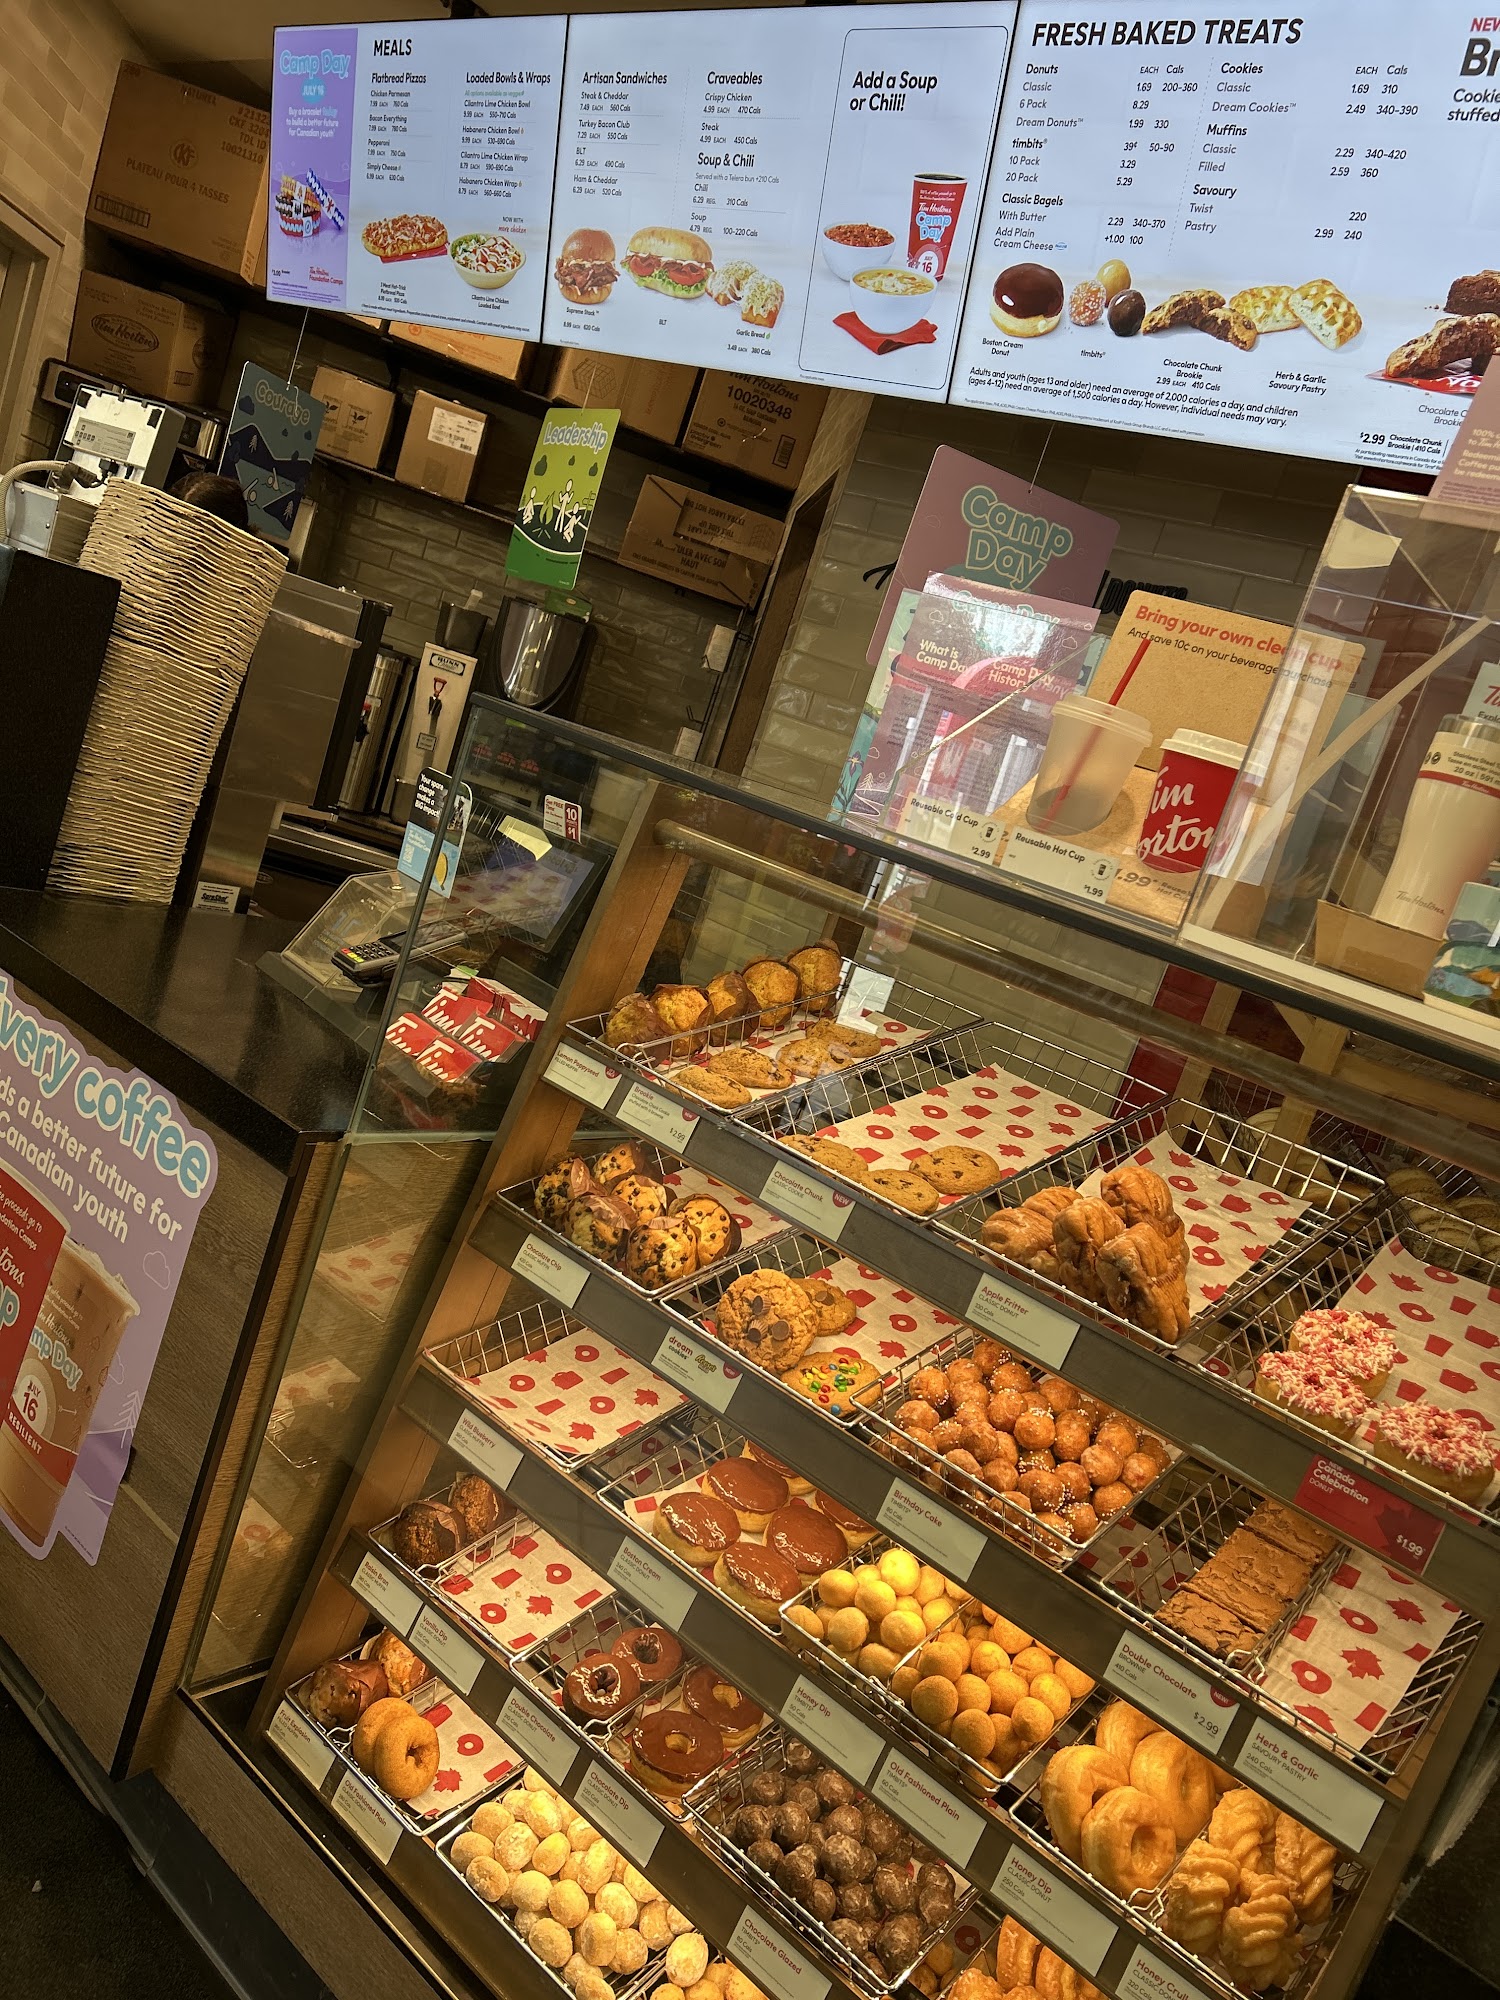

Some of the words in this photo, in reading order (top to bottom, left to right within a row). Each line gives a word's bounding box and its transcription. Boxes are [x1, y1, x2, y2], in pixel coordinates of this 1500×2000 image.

[1032, 22, 1107, 46] FRESH
[1111, 20, 1196, 45] BAKED
[1204, 18, 1304, 45] TREATS
[373, 39, 412, 56] MEALS
[280, 50, 319, 79] Camp
[320, 49, 349, 79] Day
[1026, 64, 1058, 74] Donuts
[1140, 66, 1159, 74] EACH
[1167, 64, 1184, 74] Cals
[1221, 63, 1263, 74] Cookies
[1356, 67, 1378, 75] EACH
[1387, 65, 1408, 75] Cals
[371, 73, 404, 83] Flatbread
[405, 73, 426, 83] Pizzas
[466, 72, 494, 83] Loaded
[496, 73, 516, 83] Bowls
[518, 73, 523, 83] &
[526, 72, 550, 85] Wraps
[583, 72, 614, 84] Artisan
[616, 72, 667, 85] Sandwiches
[707, 71, 762, 85] Craveables
[853, 71, 884, 89] Add
[886, 75, 895, 89] a
[899, 71, 937, 93] Soup
[1023, 82, 1052, 91] Classic
[1137, 83, 1151, 92] 1.69
[1162, 83, 1198, 92] 200-360
[1217, 82, 1251, 92] Classic
[1351, 84, 1369, 94] 1.69
[1382, 85, 1398, 94] 310
[705, 93, 725, 102] Crispy
[726, 93, 752, 101] Chicken
[850, 97, 866, 111] or
[869, 94, 905, 111] Chili!
[1019, 100, 1025, 109] 6
[1027, 99, 1047, 109] Pack
[1133, 100, 1149, 110] 8.29
[579, 120, 596, 129] Turkey
[598, 120, 615, 128] Bacon
[616, 120, 630, 129] Club
[702, 123, 719, 131] Steak
[1207, 124, 1247, 136] Muffins
[698, 153, 722, 168] Soup
[724, 154, 730, 166] &
[733, 154, 754, 167] Chili
[125, 157, 163, 180] PLATEAU
[164, 173, 188, 188] POUR
[199, 184, 230, 204] TASSES
[1193, 184, 1237, 198] Savoury
[1002, 194, 1032, 205] Classic
[1034, 195, 1063, 207] Bagels
[916, 212, 951, 227] Camp
[1185, 220, 1216, 233] Pastry
[1314, 229, 1333, 238] 2.99
[1344, 230, 1362, 240] 240
[919, 226, 943, 242] Day
[922, 262, 932, 273] 16
[1276, 371, 1294, 381] Herb
[1296, 373, 1301, 382] &
[1304, 373, 1326, 384] Garlic
[255, 379, 310, 425] Courage
[728, 384, 792, 420] 10020348
[543, 421, 608, 454] Leadership
[1360, 432, 1385, 445] $2.99
[961, 485, 1073, 559] Camp
[966, 529, 1046, 590] Day
[920, 639, 949, 656] What
[951, 646, 958, 659] is
[1128, 627, 1149, 640] And
[1150, 635, 1172, 646] save
[1174, 640, 1190, 651] 10¢
[1191, 646, 1204, 654] on
[1205, 648, 1230, 661] your
[1231, 653, 1278, 675] beverage
[1135, 605, 1179, 631] Bring
[1181, 619, 1218, 637] your
[1219, 627, 1254, 647] own
[1308, 651, 1342, 671] cup
[419, 783, 435, 799] change
[421, 773, 433, 785] Your
[431, 778, 444, 790] spare
[566, 807, 576, 821] 10
[910, 797, 944, 816] Reusable
[944, 808, 961, 821] Cold
[962, 815, 979, 828] Cup
[568, 827, 576, 839] $1
[971, 846, 991, 859] $2.99
[1015, 832, 1051, 852] Reusable
[1052, 844, 1069, 855] Hot
[1070, 850, 1086, 863] Cup
[1084, 884, 1104, 897] $1.99
[75, 1066, 212, 1199] coffee
[0, 1110, 74, 1196] Canadian
[73, 1182, 130, 1243] youth
[17, 1098, 30, 1119] a
[31, 1099, 88, 1163] better
[88, 1147, 148, 1215] future
[150, 1196, 183, 1241] for
[774, 1171, 804, 1190] Chocolate
[804, 1188, 824, 1202] Chunk
[527, 1243, 550, 1262] Chocolate
[550, 1259, 562, 1271] Chip
[981, 1287, 1003, 1302] Apple
[1004, 1298, 1029, 1315] Fritter
[669, 1336, 693, 1356] dream
[51, 1338, 82, 1392] Day
[26, 1380, 42, 1396] JULY
[23, 1391, 38, 1422] 16
[8, 1411, 42, 1455] RESILIENT
[463, 1418, 472, 1429] Wild
[473, 1427, 496, 1448] Blueberry
[1313, 1468, 1369, 1504] Celebration
[1318, 1460, 1355, 1486] Canada
[894, 1490, 924, 1514] Birthday
[925, 1511, 942, 1527] Cake
[1395, 1535, 1423, 1556] $1.99
[364, 1561, 378, 1577] Raisin
[377, 1573, 390, 1587] Bran
[624, 1547, 642, 1566] Boston
[642, 1562, 661, 1581] Cream
[423, 1616, 439, 1633] Vanilla
[438, 1630, 448, 1642] Dip
[1122, 1644, 1152, 1669] Double
[1153, 1662, 1197, 1699] Chocolate
[796, 1687, 819, 1708] Honey
[818, 1704, 832, 1718] Dip
[1214, 1691, 1230, 1705] NEW!
[280, 1710, 291, 1721] Fruit
[290, 1719, 311, 1743] Explosion
[510, 1698, 531, 1717] Double
[531, 1714, 556, 1742] Chocolate
[1194, 1712, 1219, 1735] $2.99
[1255, 1732, 1279, 1753] Herb
[1281, 1750, 1289, 1759] &
[1290, 1753, 1320, 1780] Garlic
[344, 1779, 354, 1791] Old
[353, 1786, 375, 1815] Fashioned
[375, 1812, 387, 1826] Plain
[590, 1772, 619, 1802] Chocolate
[619, 1798, 629, 1811] Dip
[890, 1761, 904, 1776] Old
[903, 1771, 941, 1806] Fashioned
[940, 1801, 960, 1821] Plain
[1011, 1858, 1037, 1881] Honey
[1038, 1878, 1052, 1894] Dip
[745, 1919, 777, 1952] Chocolate
[778, 1950, 802, 1975] Glazed
